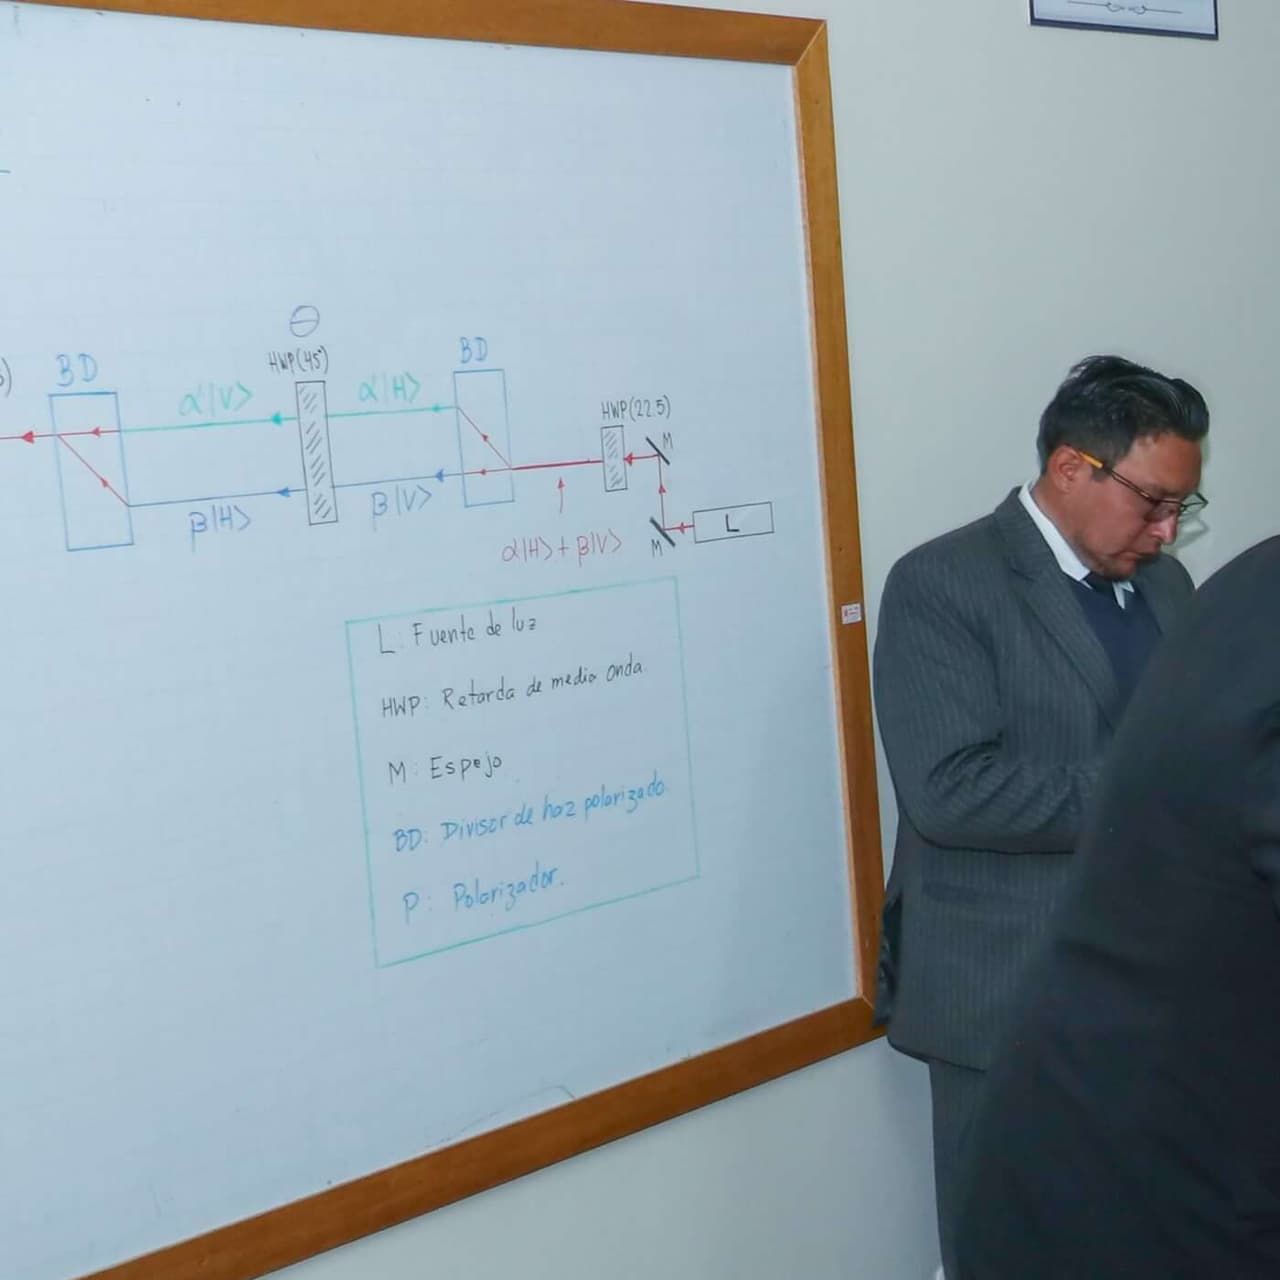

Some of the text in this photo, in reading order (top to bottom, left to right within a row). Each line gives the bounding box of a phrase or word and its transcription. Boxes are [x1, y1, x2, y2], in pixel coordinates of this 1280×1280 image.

[460, 337, 489, 365] BD
[55, 353, 99, 388] BD
[662, 432, 673, 449] M
[724, 513, 740, 534] L
[651, 538, 664, 559] M
[412, 613, 476, 647] Fuente
[486, 609, 502, 637] de
[511, 606, 537, 632] luz
[526, 676, 543, 698] de
[429, 751, 503, 782] Espejo
[513, 801, 534, 826] de
